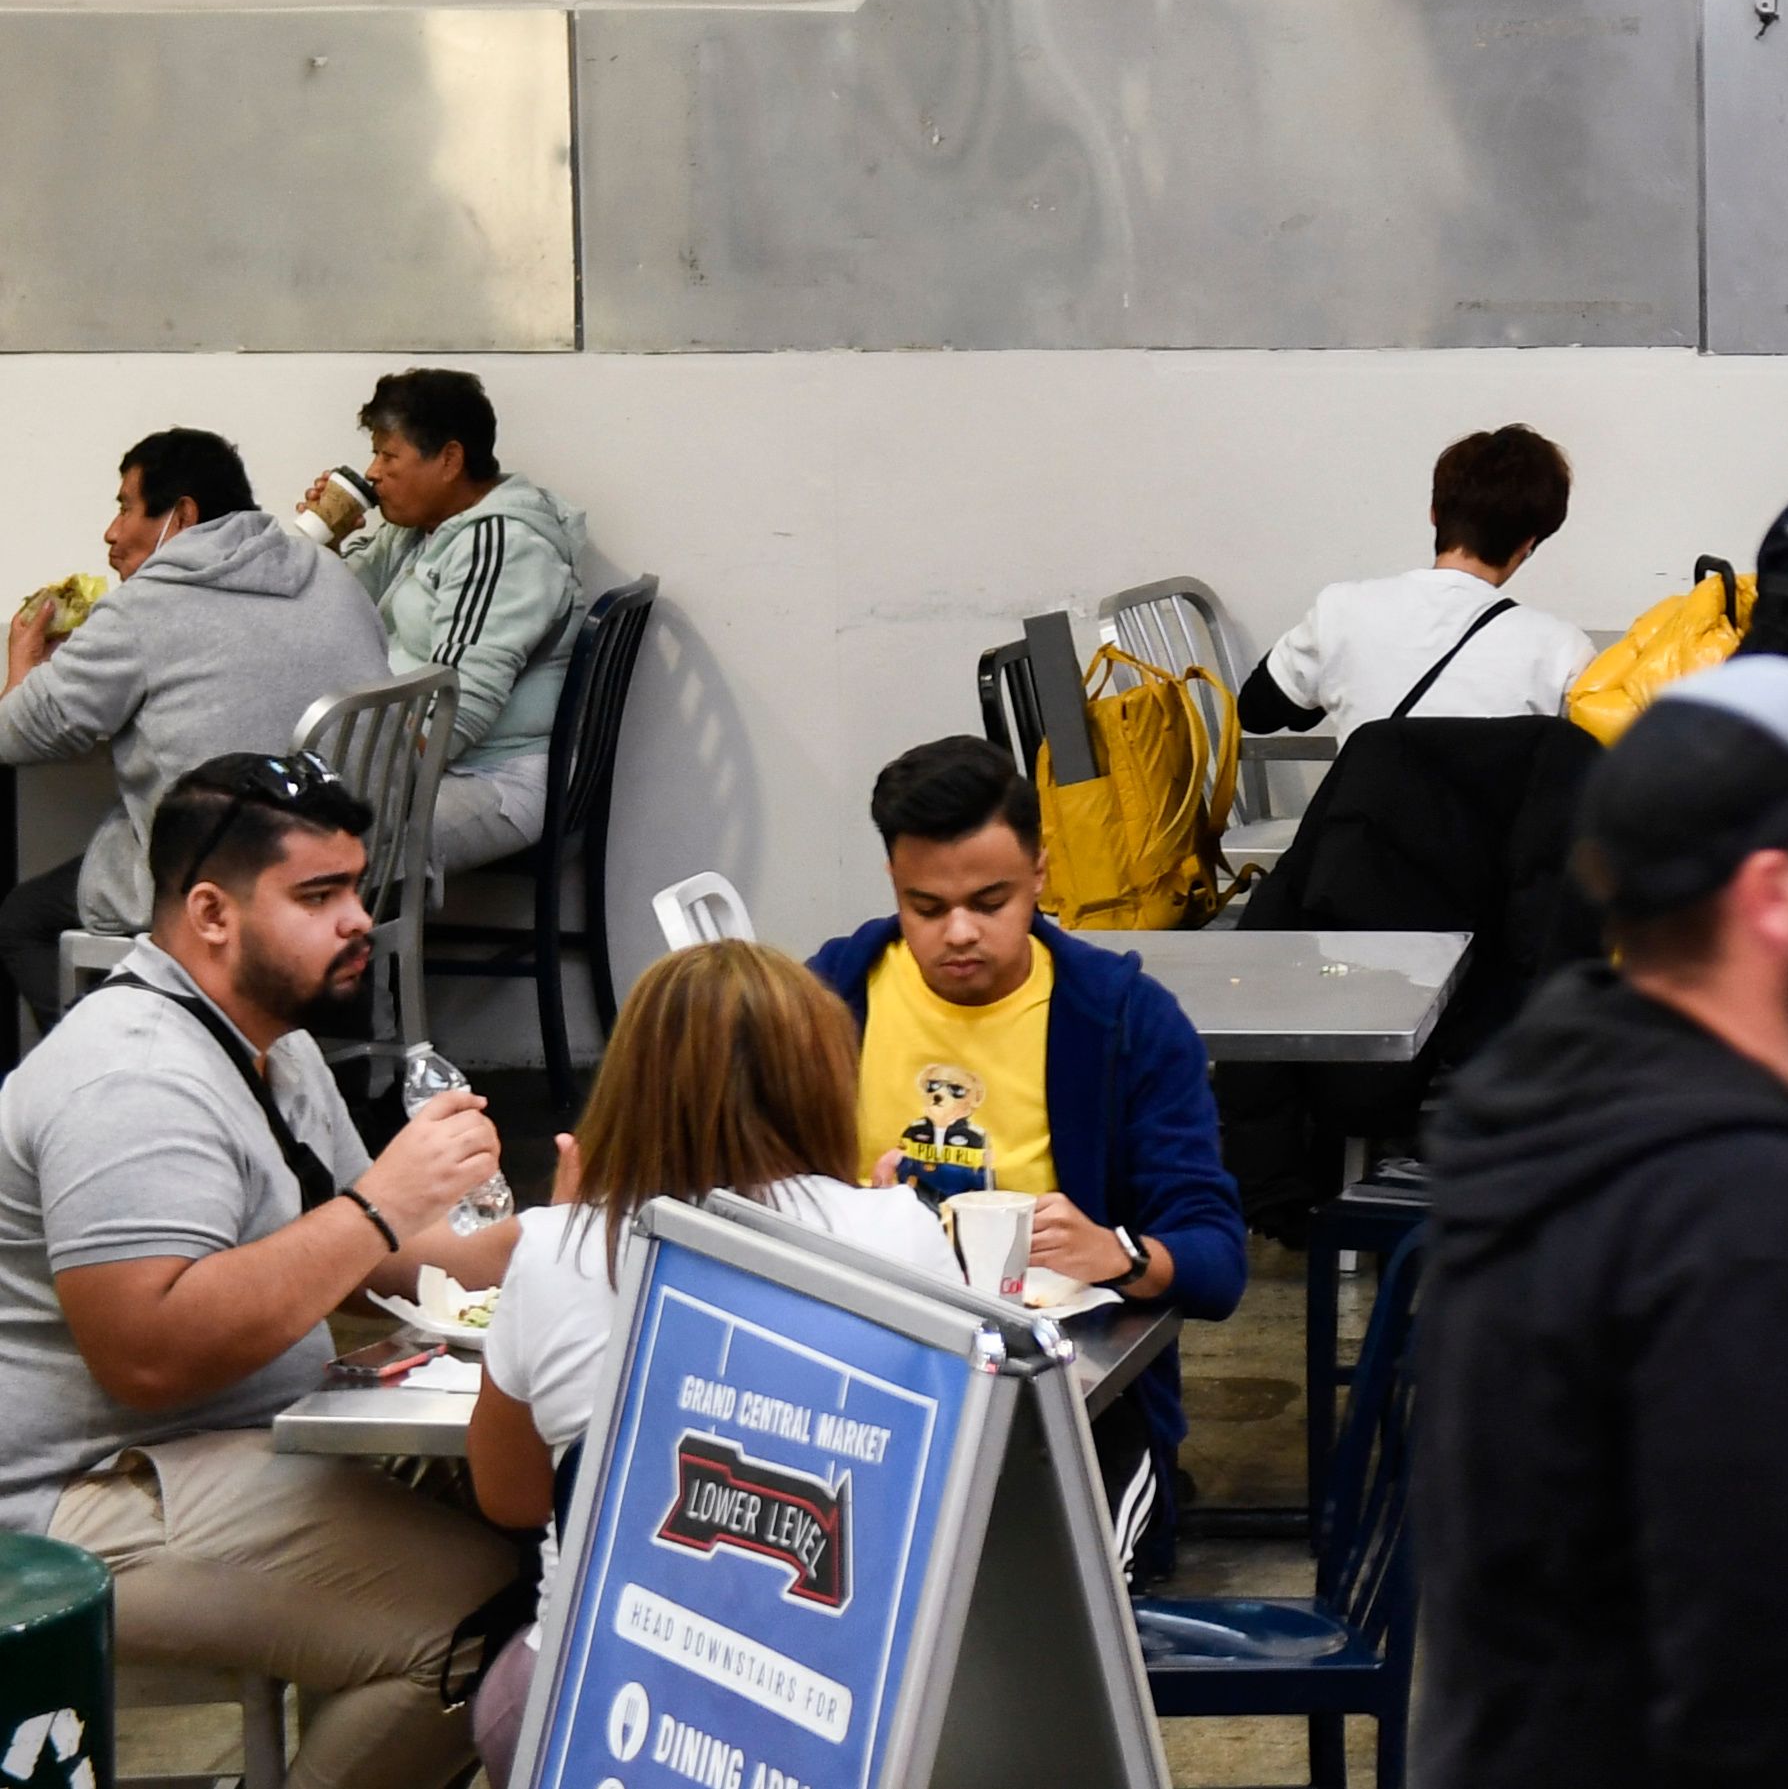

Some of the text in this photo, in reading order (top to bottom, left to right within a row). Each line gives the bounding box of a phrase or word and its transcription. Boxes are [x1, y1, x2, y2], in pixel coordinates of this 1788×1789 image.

[678, 1374, 892, 1464] GRAND CENTRAL MARKET
[686, 1478, 828, 1580] LOWER LEVEL
[630, 1602, 838, 1724] HEAD DOWNSTAIRS FOR
[652, 1713, 745, 1789] DINING
